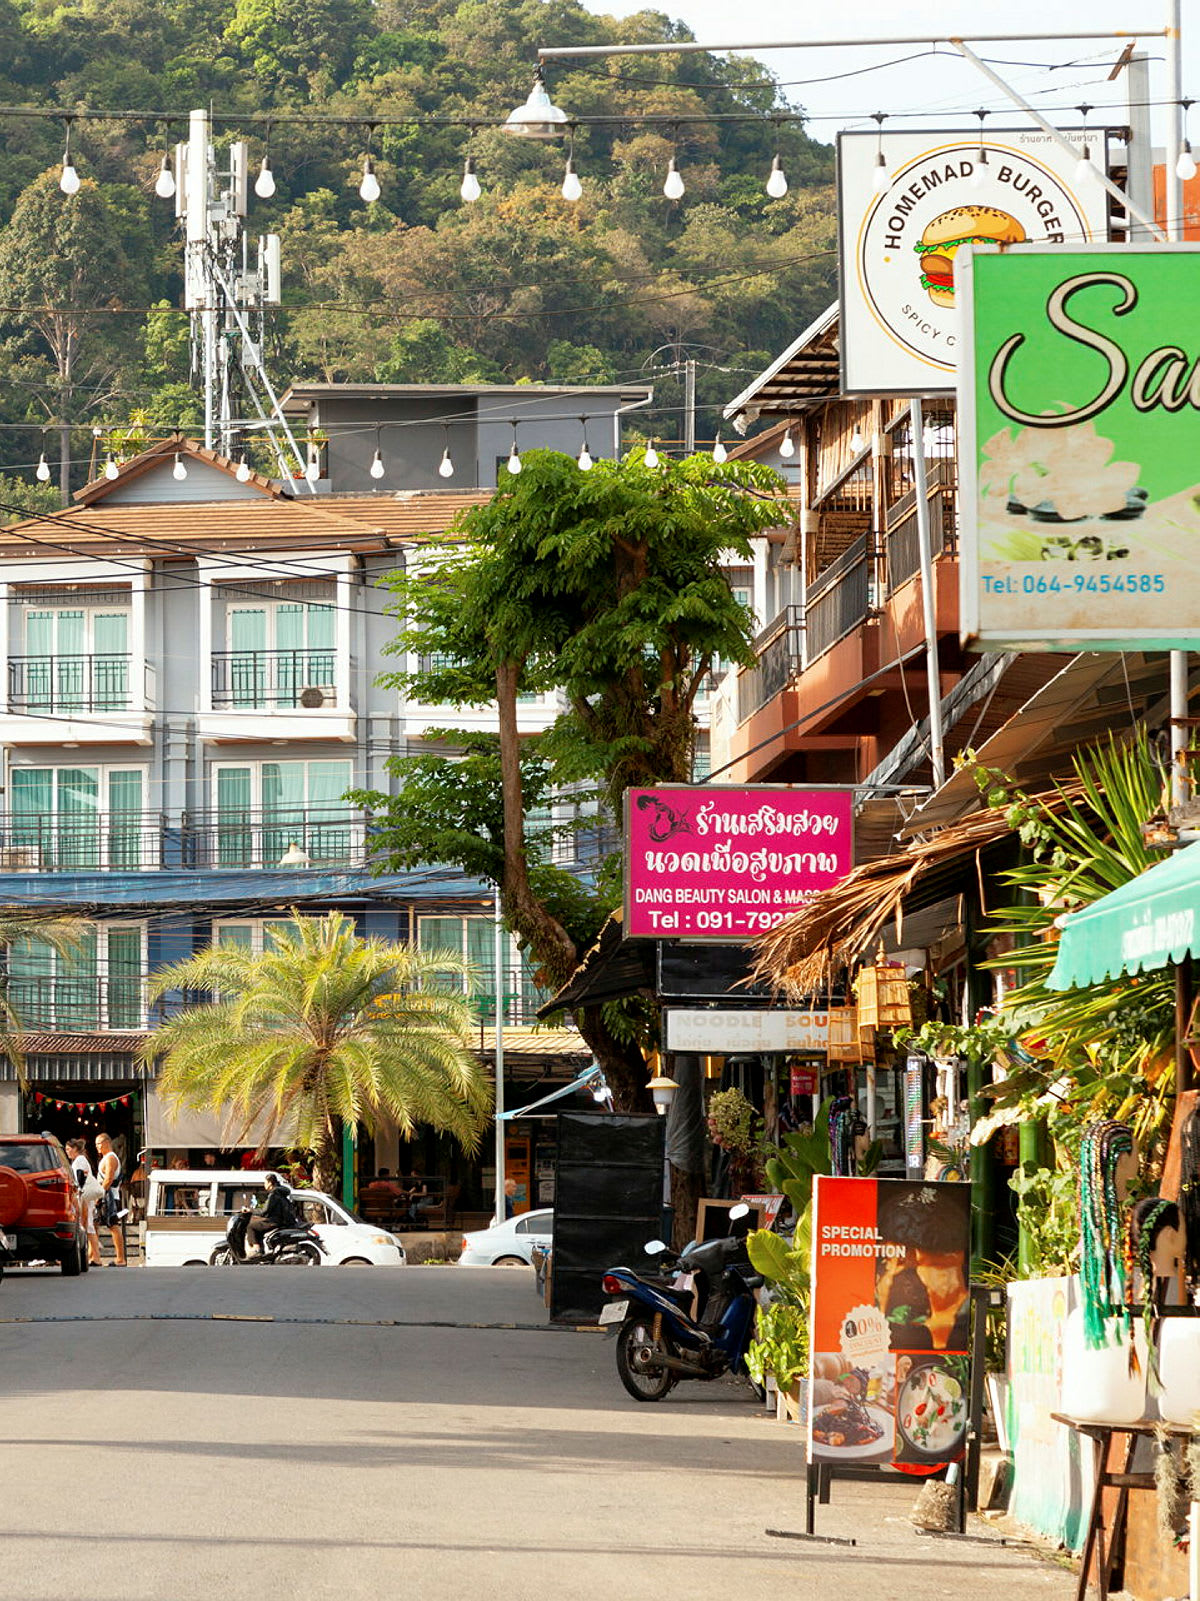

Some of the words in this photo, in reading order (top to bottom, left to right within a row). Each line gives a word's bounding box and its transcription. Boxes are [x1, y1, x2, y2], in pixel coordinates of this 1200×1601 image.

[883, 160, 988, 250] HOMEMAD
[997, 165, 1064, 244] BURGER
[901, 304, 941, 340] SPICY
[982, 576, 1018, 594] Tel:
[1022, 574, 1165, 594] 064-9454585
[695, 801, 840, 836] ร้านเสริมสวย
[635, 888, 673, 904] DANG
[675, 888, 725, 904] BEAUTY
[727, 889, 771, 904] SALON
[773, 889, 783, 904] &
[648, 910, 680, 929] Tel
[676, 1015, 762, 1028] NOODLE
[784, 1015, 828, 1028] SOU
[821, 1226, 883, 1240] SPECIAL
[821, 1243, 906, 1258] PROMOTION
